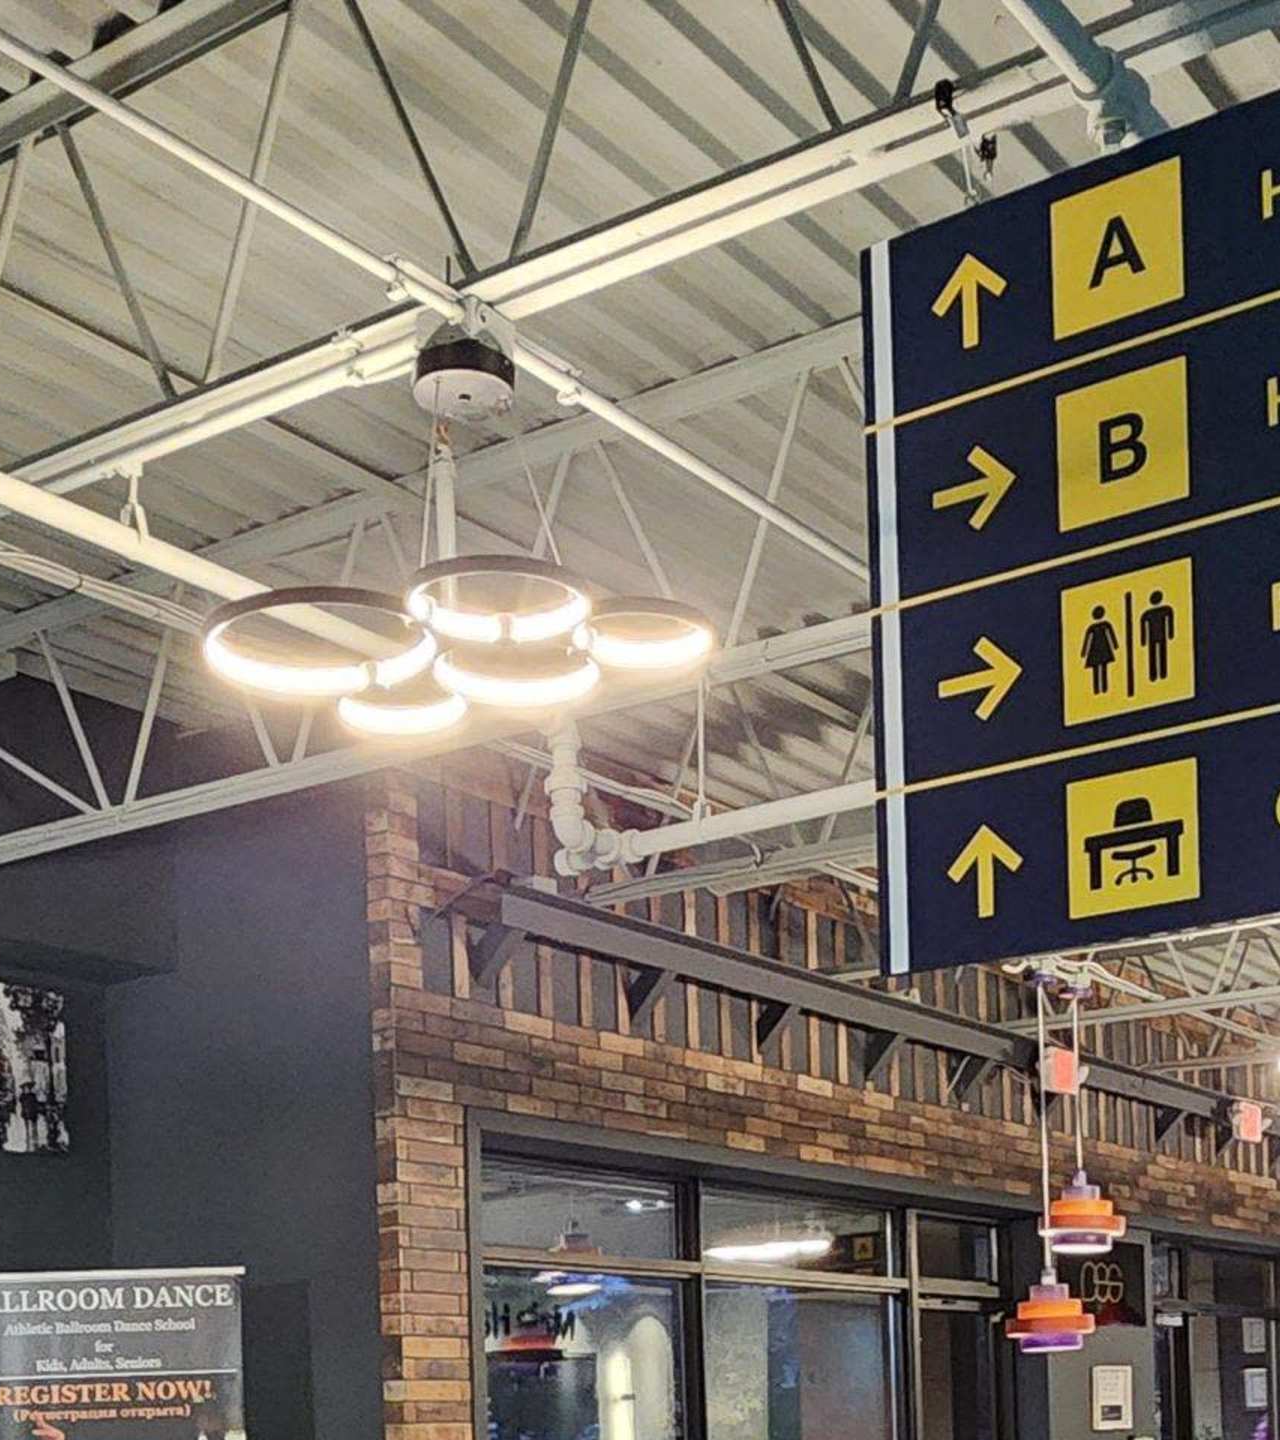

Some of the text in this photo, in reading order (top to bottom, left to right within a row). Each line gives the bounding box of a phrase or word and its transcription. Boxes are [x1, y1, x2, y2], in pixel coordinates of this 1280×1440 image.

[1089, 215, 1146, 289] A
[1099, 412, 1147, 484] B
[133, 1284, 234, 1309] DANCE
[4, 1318, 196, 1336] Athletic Ballroom Dance School
[94, 1340, 114, 1353] for
[36, 1356, 162, 1373] Kids, Adults, Seniors
[136, 1381, 212, 1402] NOW!
